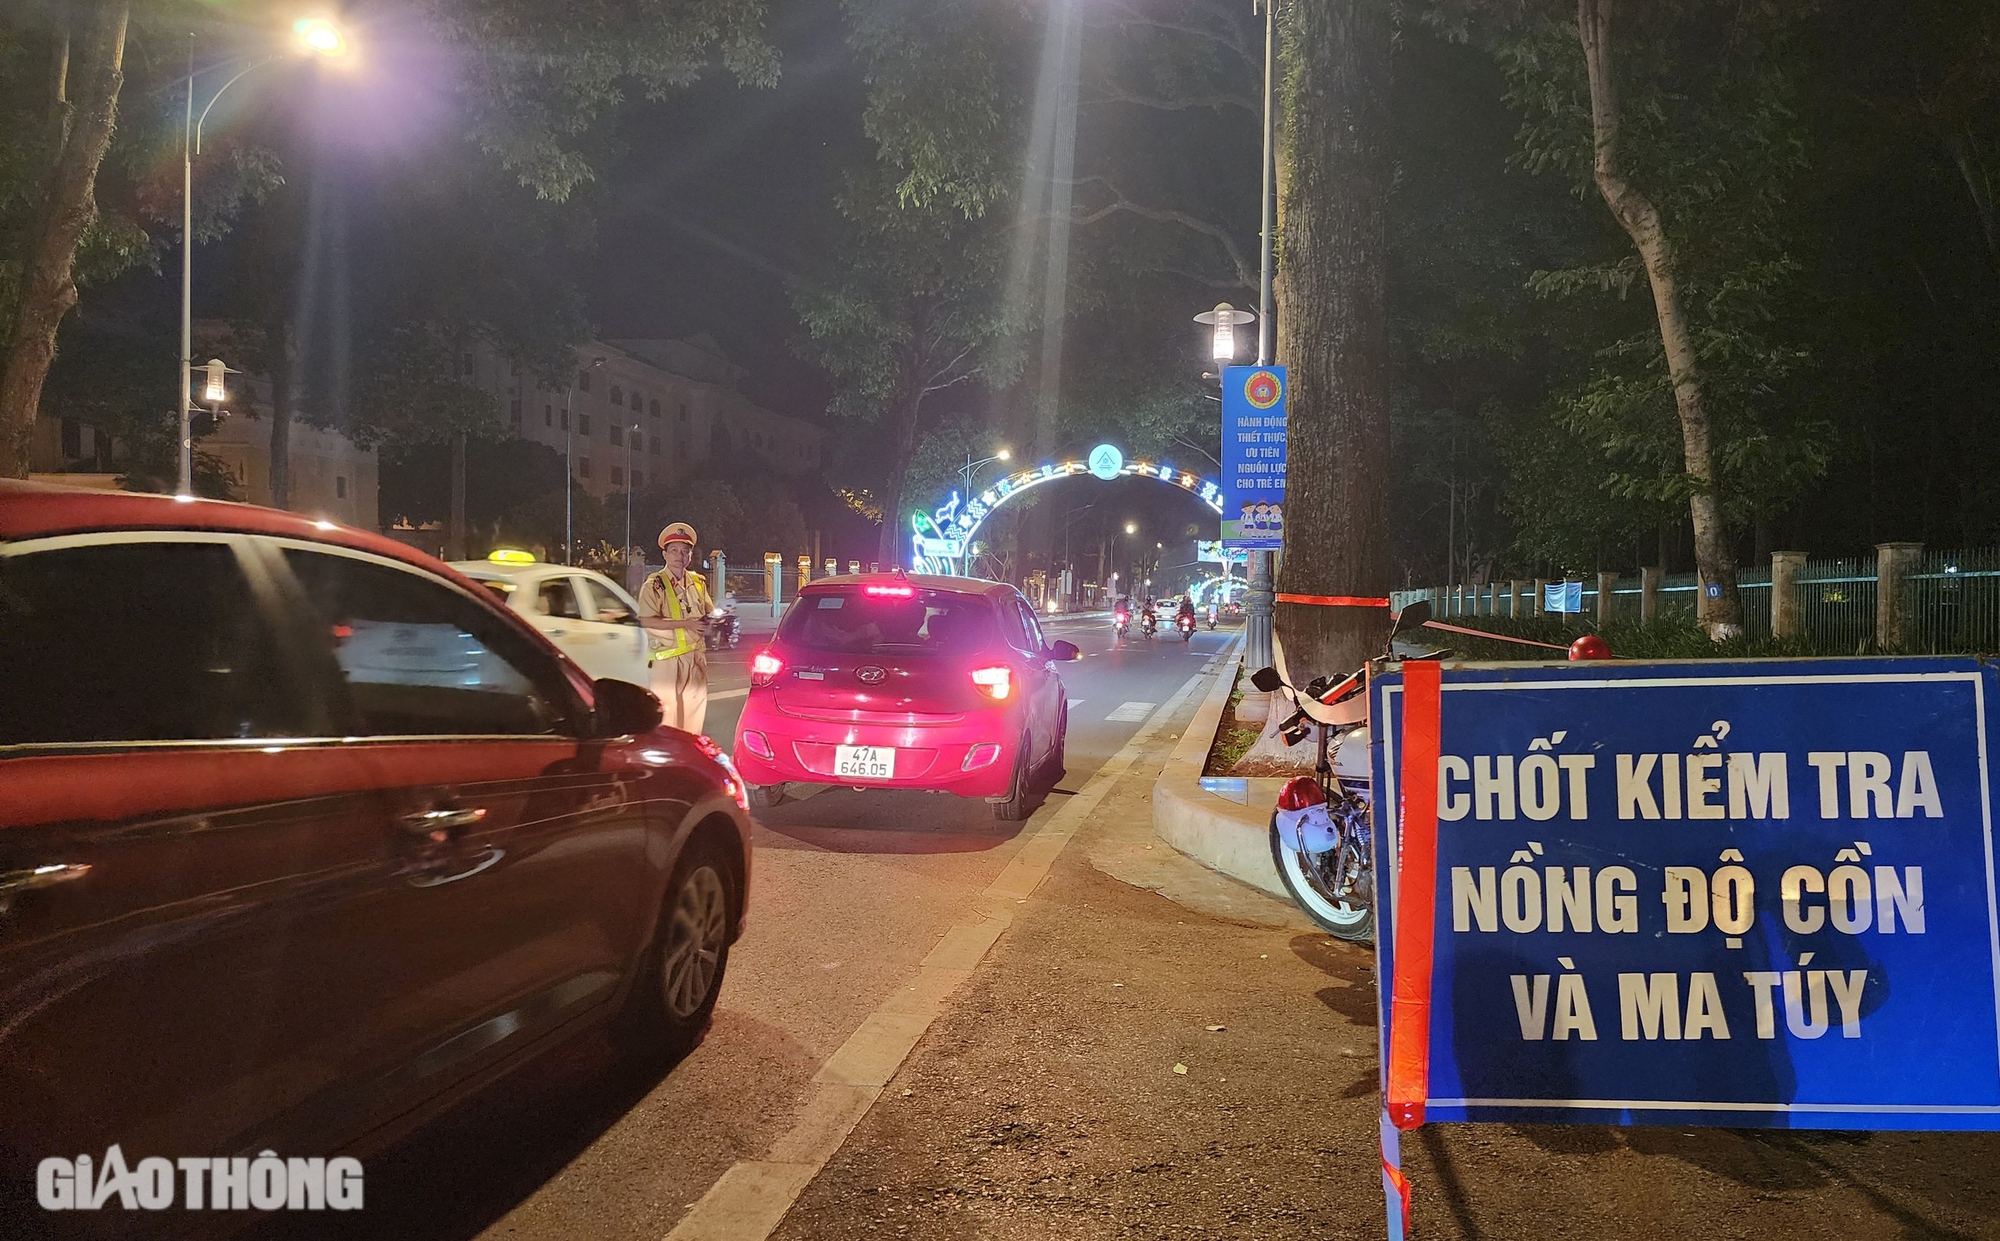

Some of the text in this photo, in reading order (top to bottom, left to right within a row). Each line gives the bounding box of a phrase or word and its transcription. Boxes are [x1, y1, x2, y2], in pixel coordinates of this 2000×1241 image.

[1237, 415, 1287, 429] HÀNH ĐỘNG
[1237, 430, 1261, 443] THIẾT
[1245, 446, 1280, 458] ƯU TIÊN
[1270, 463, 1287, 475] LỰC
[1236, 478, 1255, 489] CHO
[1256, 475, 1272, 489] TRẺ
[852, 748, 877, 762] 47A
[841, 761, 887, 776] 646.05
[1436, 721, 1945, 821] CHỐT KIỂM TRA
[1451, 841, 1926, 949] NỒNG ĐỘ CỒN
[1510, 953, 1869, 1042] VÀ MA TÚY
